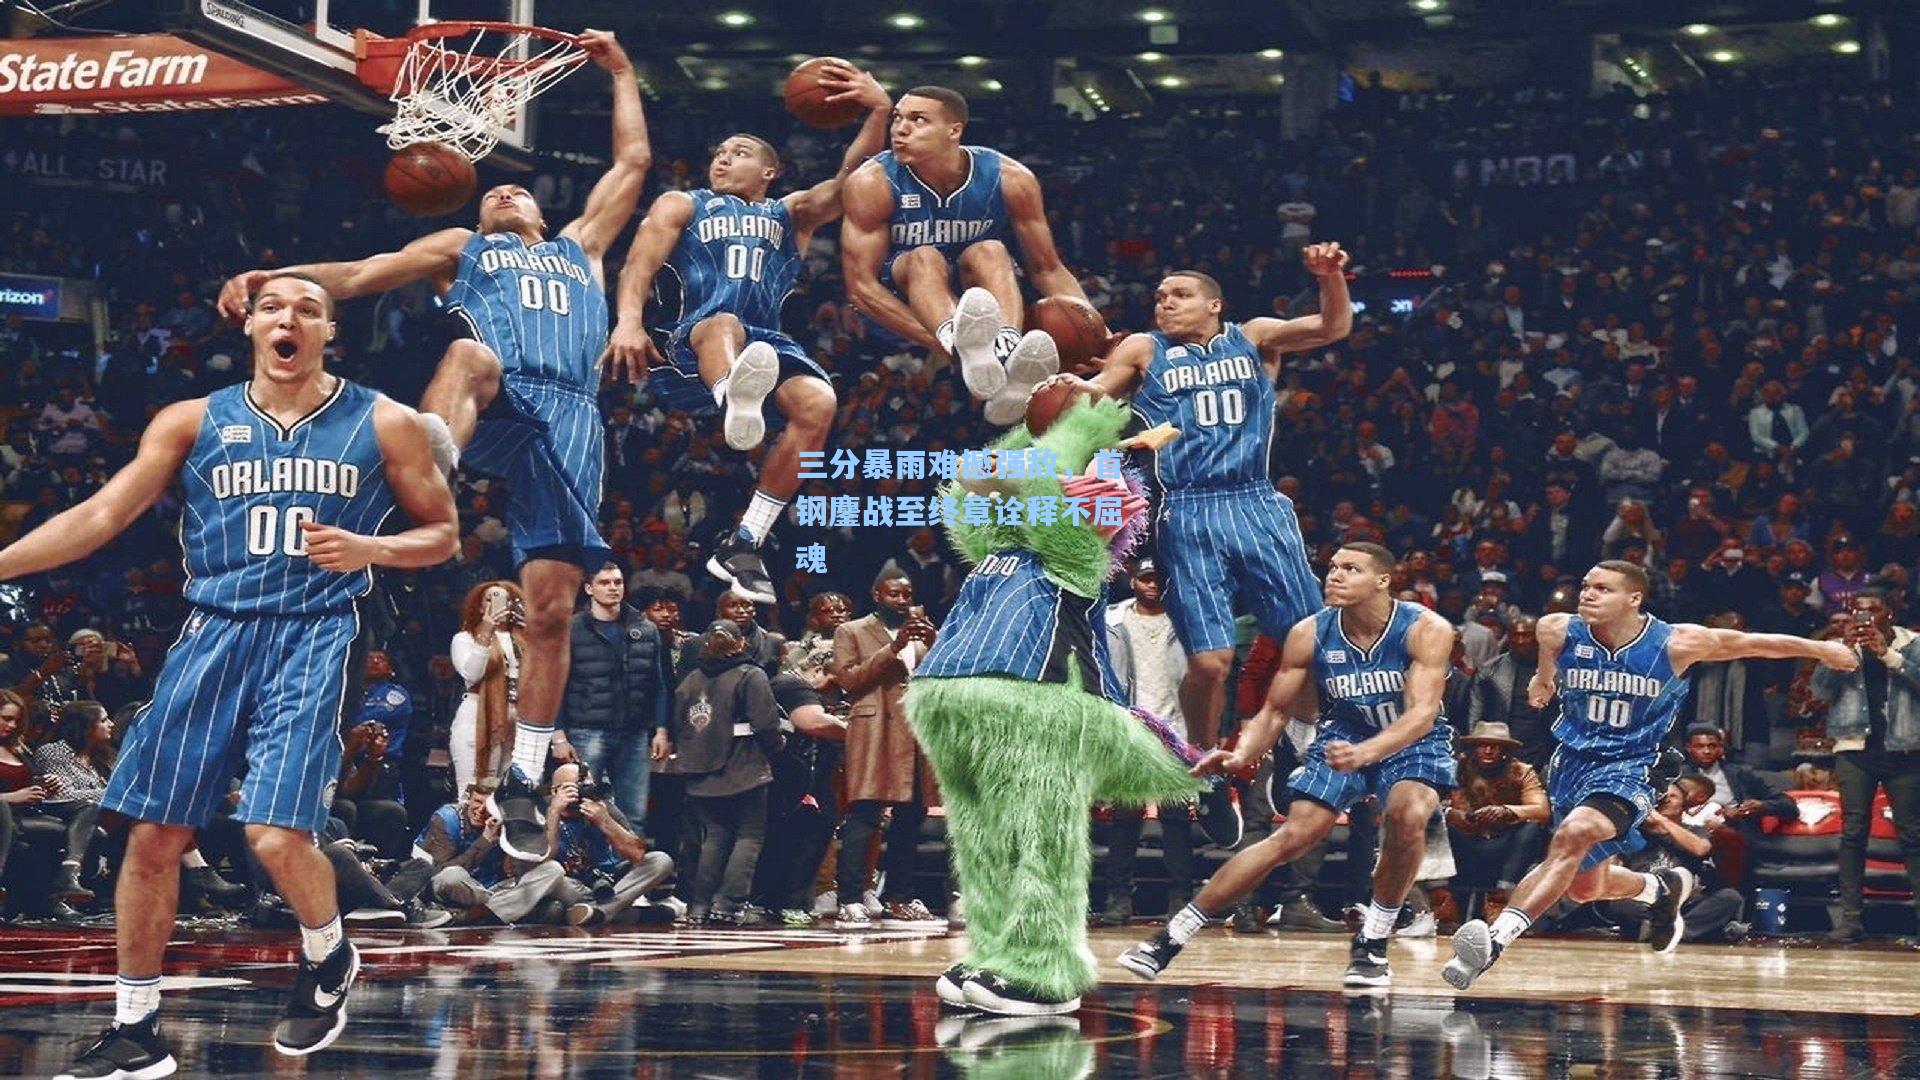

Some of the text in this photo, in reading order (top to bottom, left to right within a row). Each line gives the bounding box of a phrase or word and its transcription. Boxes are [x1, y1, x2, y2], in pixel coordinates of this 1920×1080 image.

[97, 157, 168, 187] STAR
[519, 273, 569, 316] 00
[1195, 388, 1244, 427] 00
[211, 456, 360, 500] ORLANDO
[1325, 669, 1405, 699] ORLAND
[1566, 667, 1661, 698] ORLANDO
[1587, 694, 1631, 729] 00
